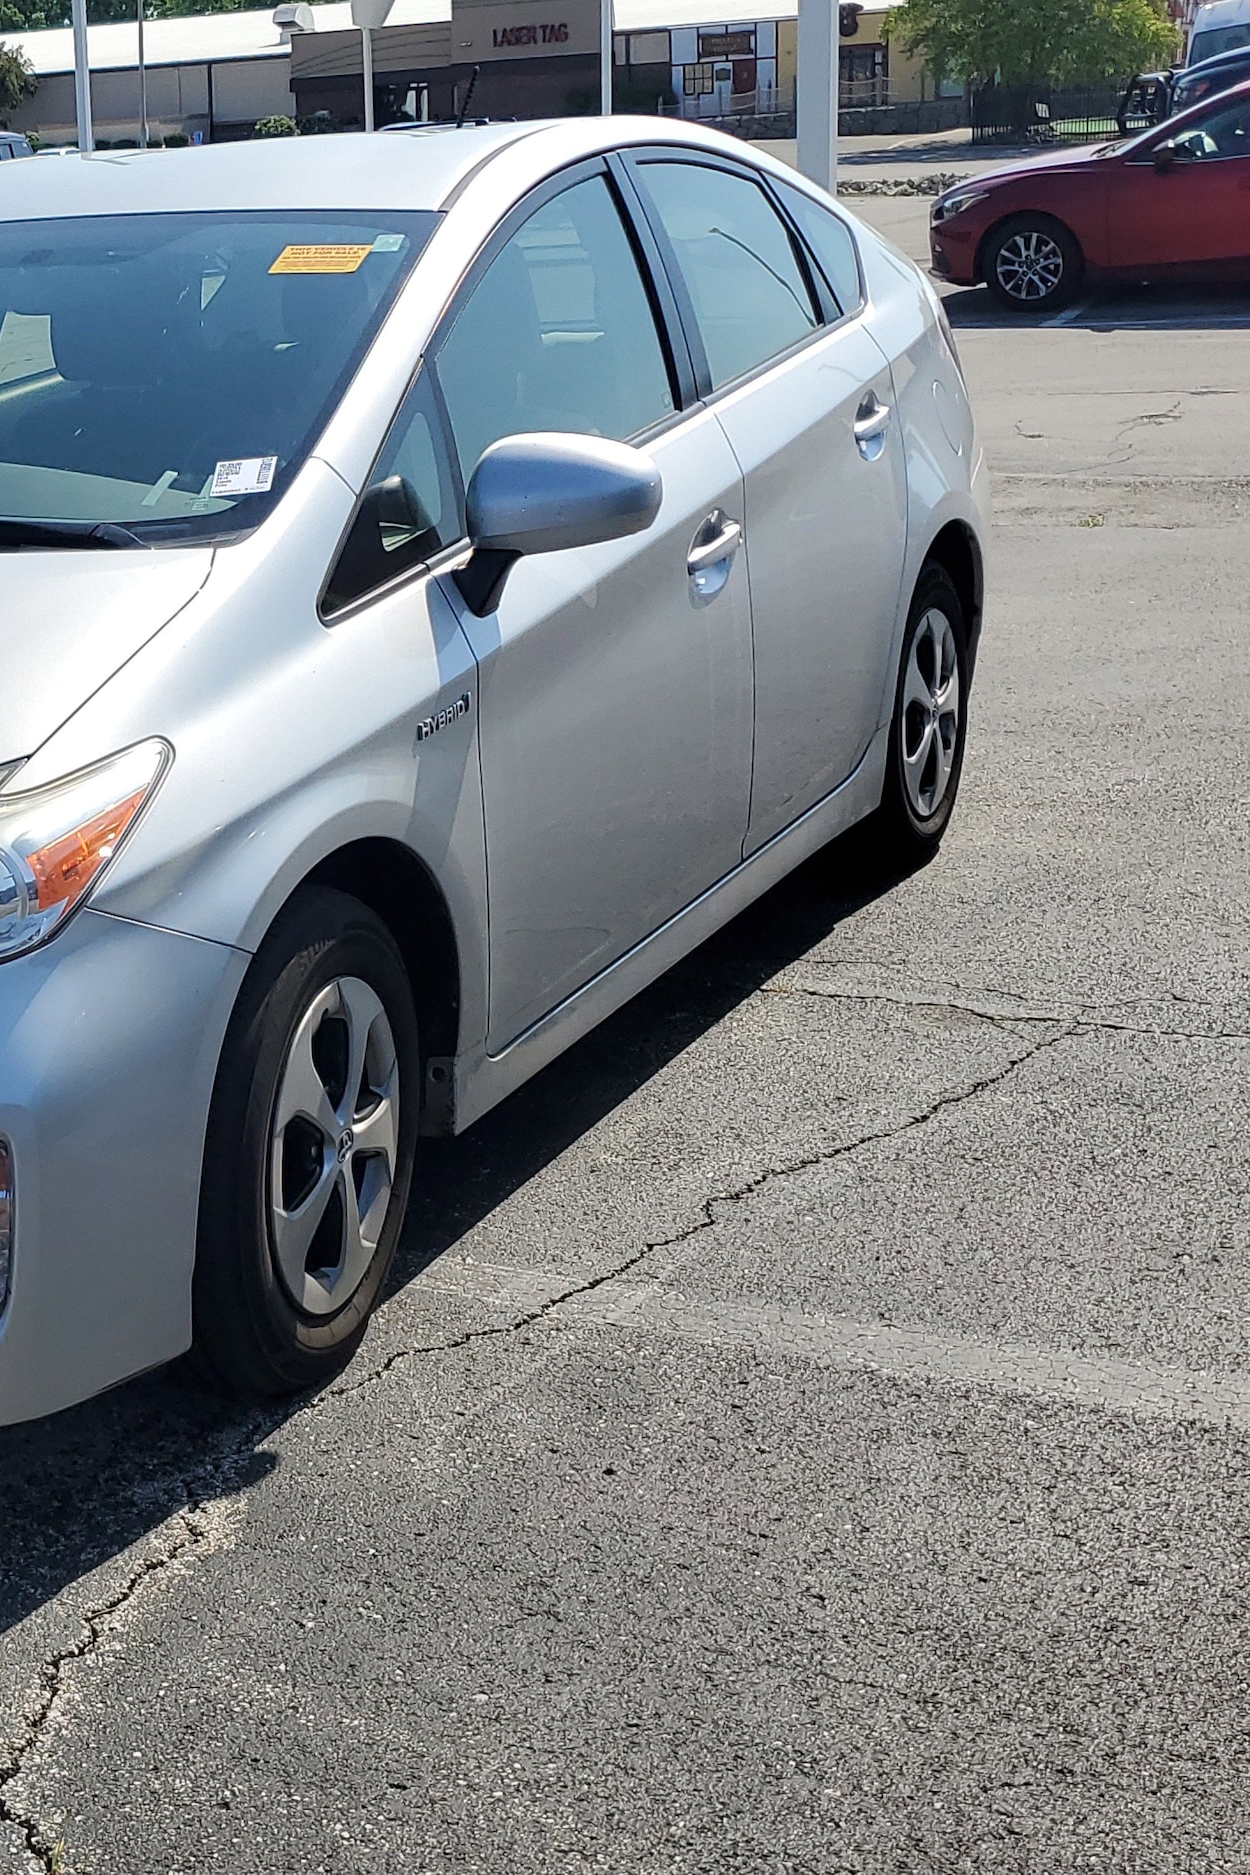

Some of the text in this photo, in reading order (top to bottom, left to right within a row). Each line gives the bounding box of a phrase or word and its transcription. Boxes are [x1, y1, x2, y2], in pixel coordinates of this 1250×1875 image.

[492, 23, 569, 48] LASER TAG
[419, 696, 467, 740] HYBRID
